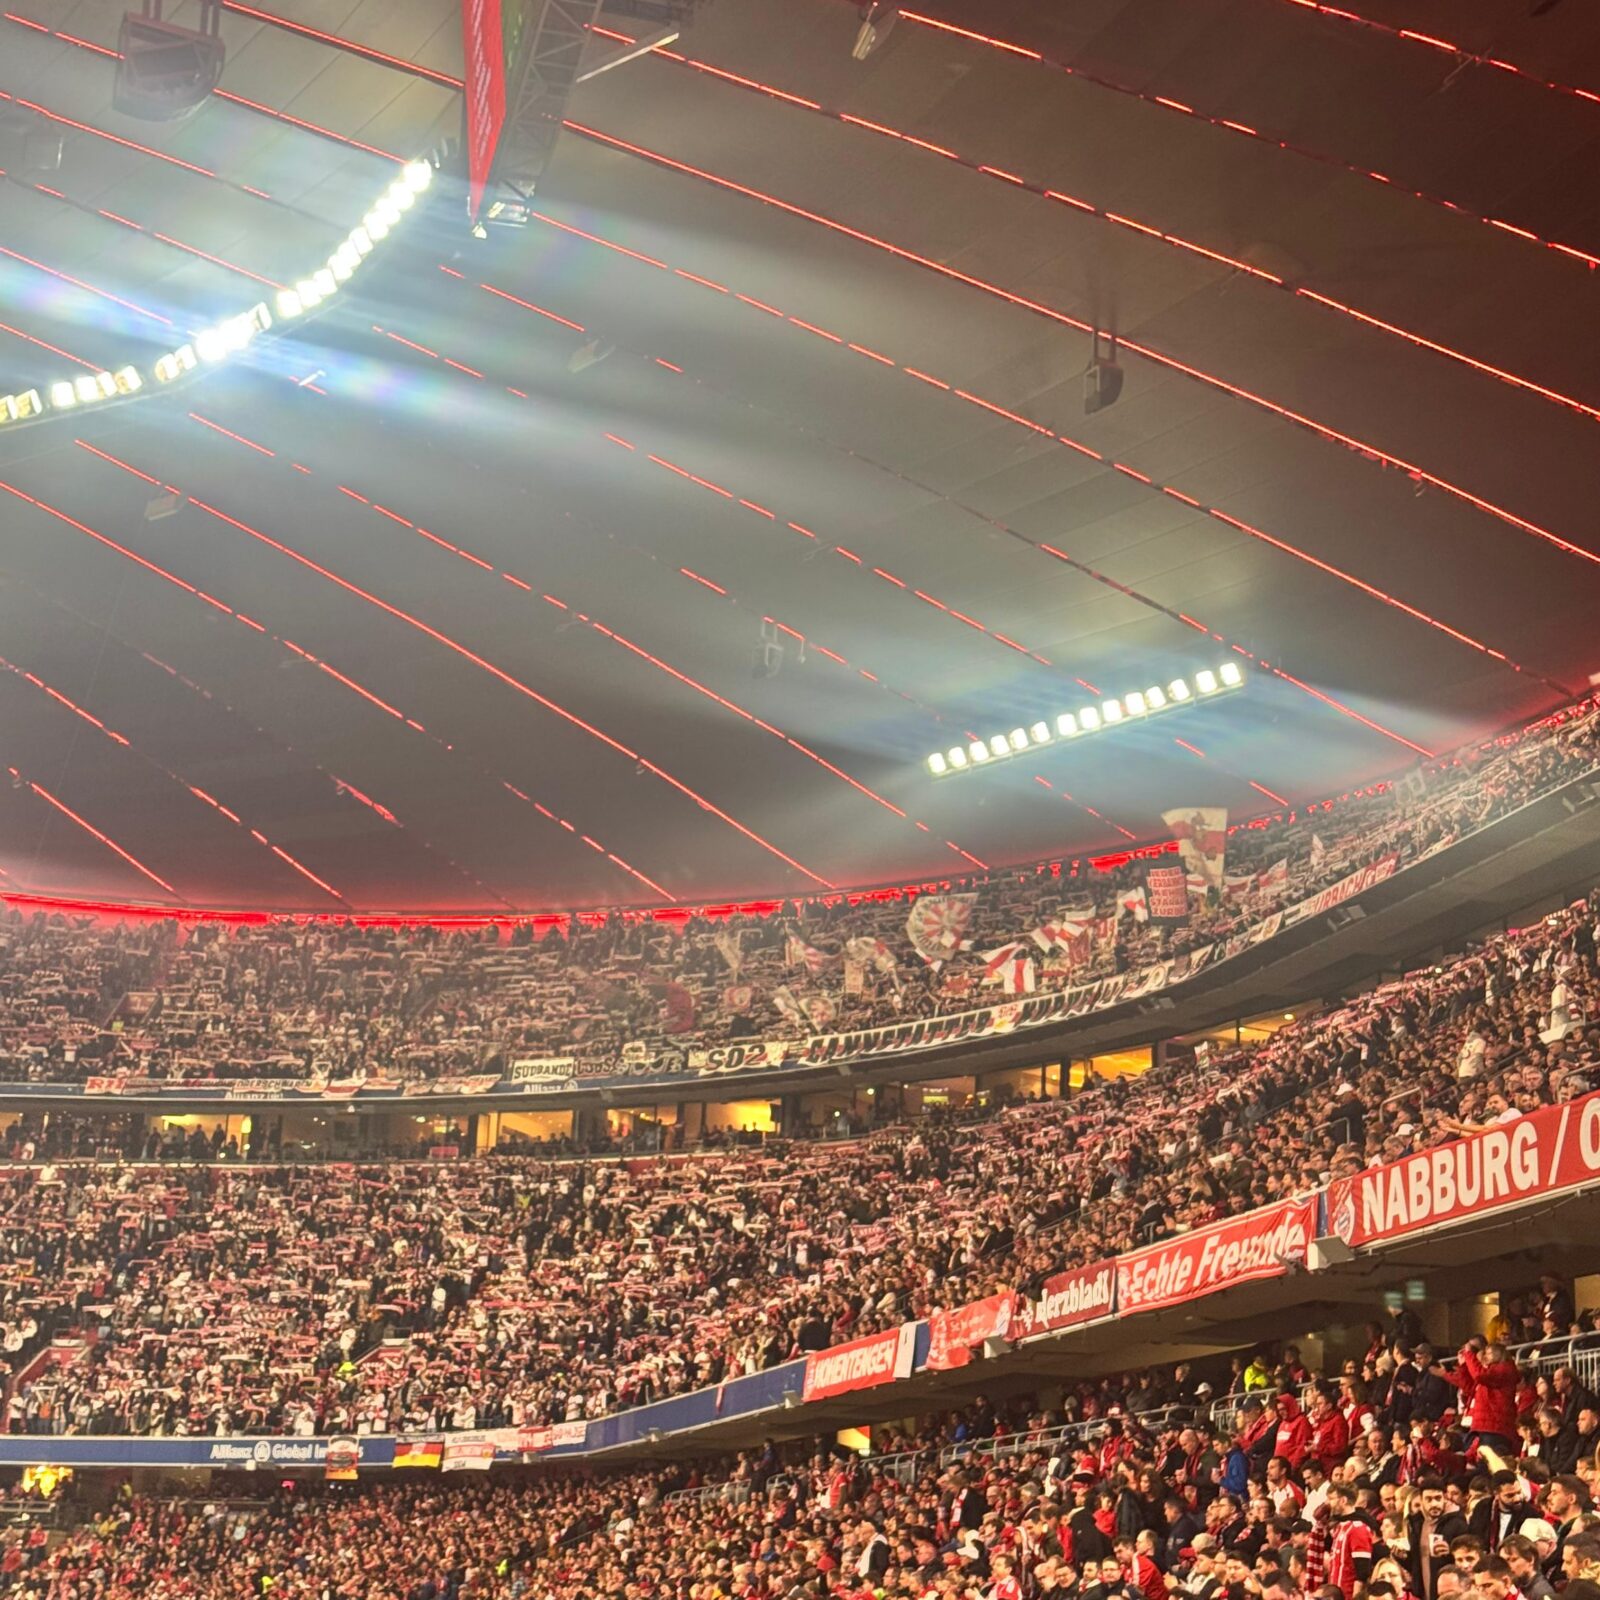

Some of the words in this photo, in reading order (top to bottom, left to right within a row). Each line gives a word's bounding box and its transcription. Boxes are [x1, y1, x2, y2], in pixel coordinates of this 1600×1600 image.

[1361, 1121, 1540, 1236] NABBURG
[1131, 1246, 1192, 1302] Echte
[1193, 1211, 1306, 1284] Freunde
[209, 1443, 252, 1460] Allianz
[271, 1443, 312, 1460] Global
